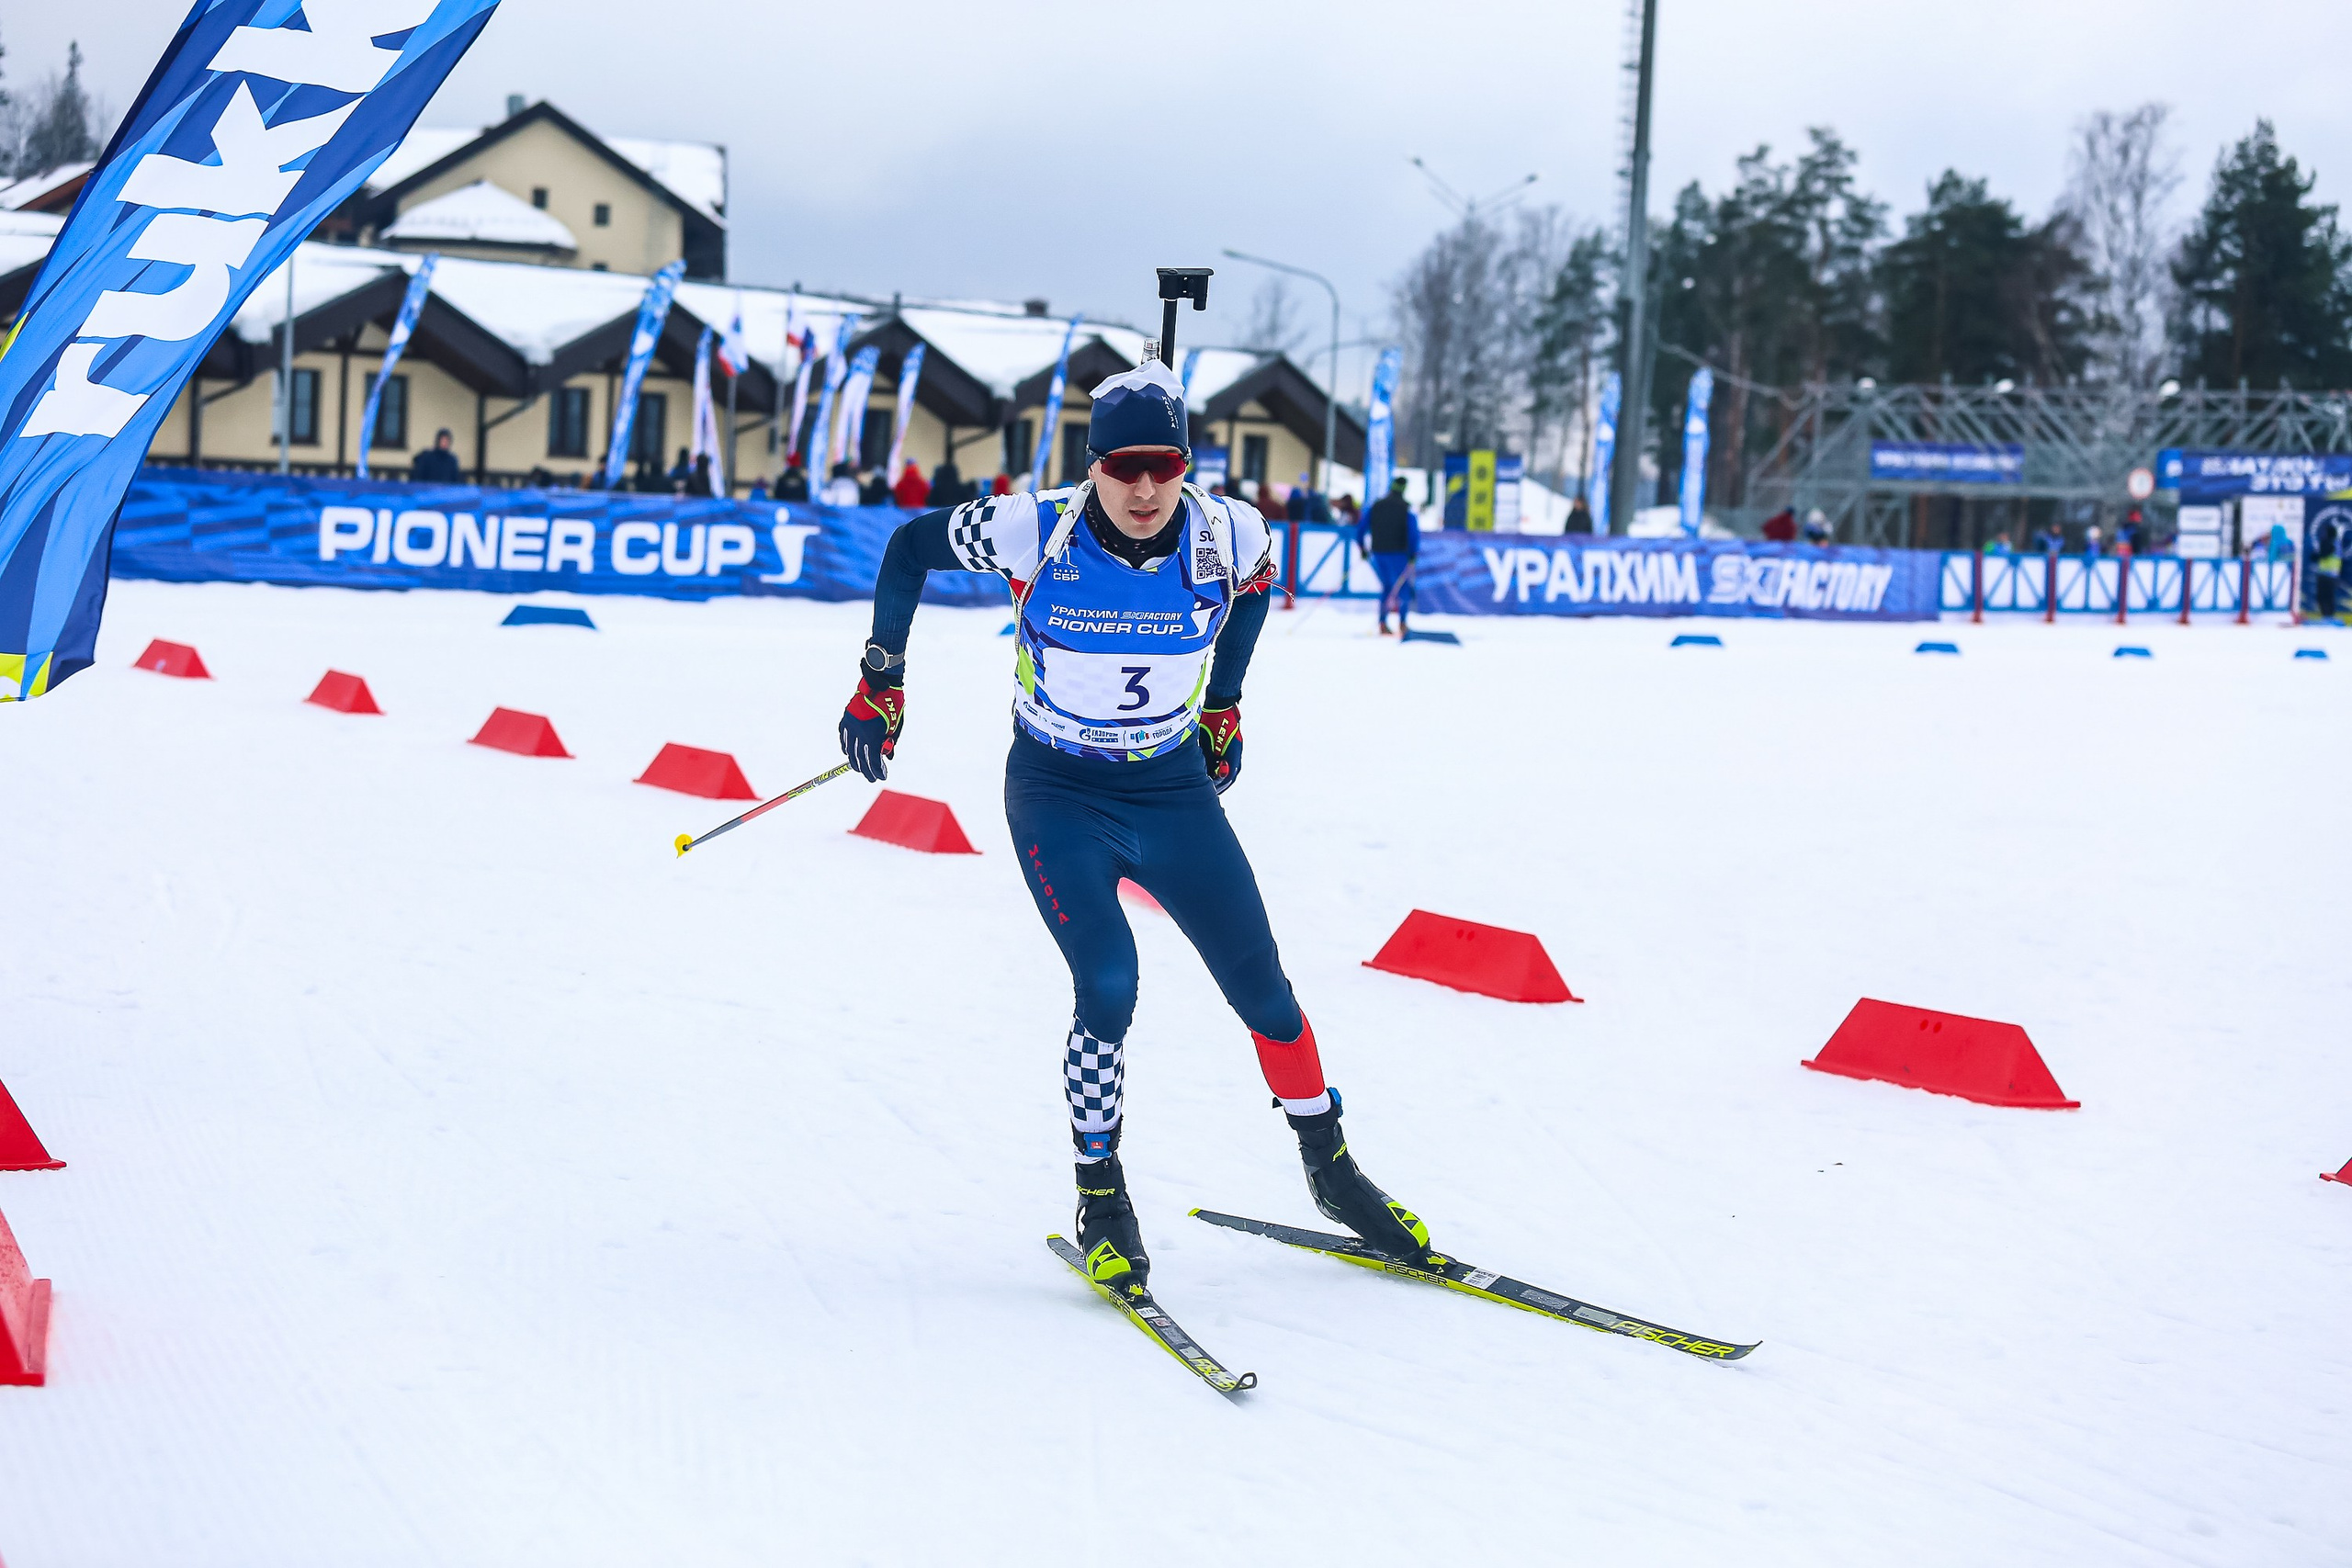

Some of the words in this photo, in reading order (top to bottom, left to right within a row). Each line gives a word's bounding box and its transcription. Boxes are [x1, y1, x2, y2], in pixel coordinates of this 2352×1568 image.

[319, 506, 595, 573] PIONER
[610, 522, 756, 577] CUP
[1053, 572, 1080, 581] СБР
[1483, 547, 1701, 604] УРАЛХИМ
[1047, 616, 1133, 635] PIONER
[1136, 624, 1184, 636] CUP
[1051, 604, 1118, 619] УРАЛХИМ
[1117, 667, 1151, 711] 3
[1215, 717, 1229, 752] LEKI
[1028, 843, 1070, 925] MALOJA
[1384, 1264, 1449, 1287] FISCHER
[1611, 1320, 1736, 1358] FISCHER
